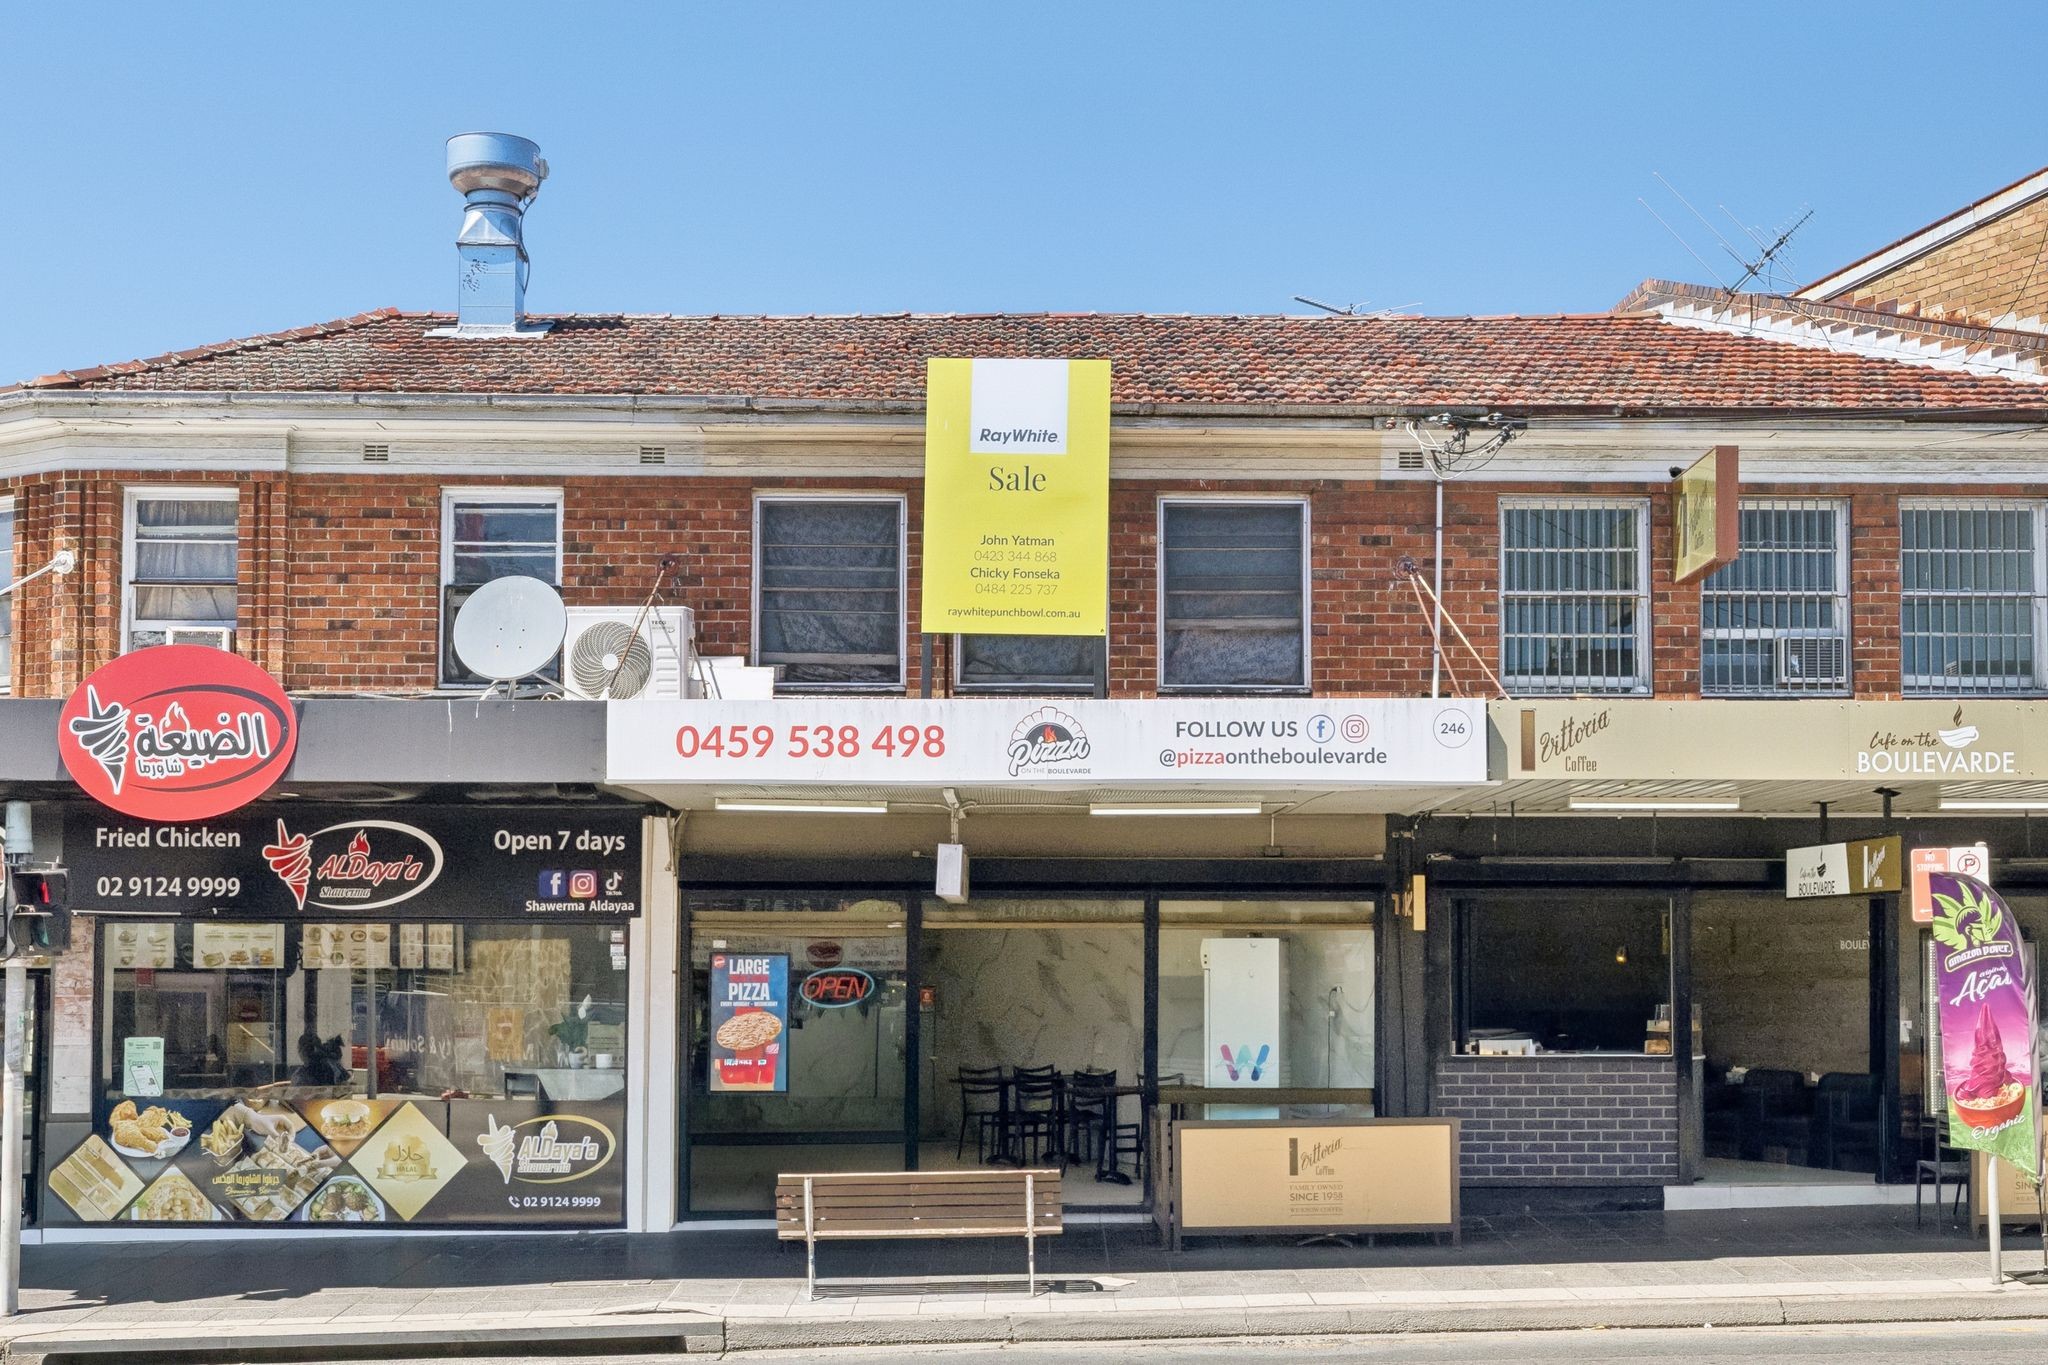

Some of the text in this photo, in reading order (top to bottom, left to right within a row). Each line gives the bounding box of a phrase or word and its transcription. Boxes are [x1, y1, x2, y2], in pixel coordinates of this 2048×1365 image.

[989, 465, 1047, 492] Sale
[980, 535, 1055, 547] John Yatman
[974, 551, 1057, 563] 0423 344 868
[970, 567, 1060, 581] Chicky Fonseka
[975, 583, 1058, 596] 0484 225 737
[947, 606, 1081, 619] raywhitepunchbowl.com.au
[1175, 721, 1265, 738] FOLLOW
[1271, 721, 1298, 738] US
[1440, 722, 1465, 735] 246
[1540, 709, 1611, 763] Vittoria
[136, 712, 269, 766] الضيعة
[675, 725, 945, 758] 0459 538 498
[1869, 731, 1939, 750] Café on the
[1007, 736, 1091, 777] Pizza
[1159, 747, 1387, 769] @pizzaontheboulevarde
[1565, 755, 1597, 772] Coffee
[1857, 751, 2015, 774] BOULEVARDE
[136, 757, 183, 778] شاورما
[96, 827, 241, 848] Fried Chicken
[494, 829, 626, 856] Open 7 days
[1924, 854, 1936, 862] NO
[96, 877, 241, 897] 02 9124 9999
[525, 900, 635, 914] Shawerma Aldayaa
[729, 958, 770, 975] LARGE
[728, 982, 771, 1001] PIZZA
[803, 976, 868, 999] OPEN
[1971, 1114, 2026, 1141] Organic
[391, 1144, 424, 1162] حلال
[1300, 1137, 1343, 1171] Vittoria
[396, 1165, 417, 1173] HALAL
[523, 1196, 601, 1207] 02 9124 9999
[1289, 1192, 1319, 1201] SINCE
